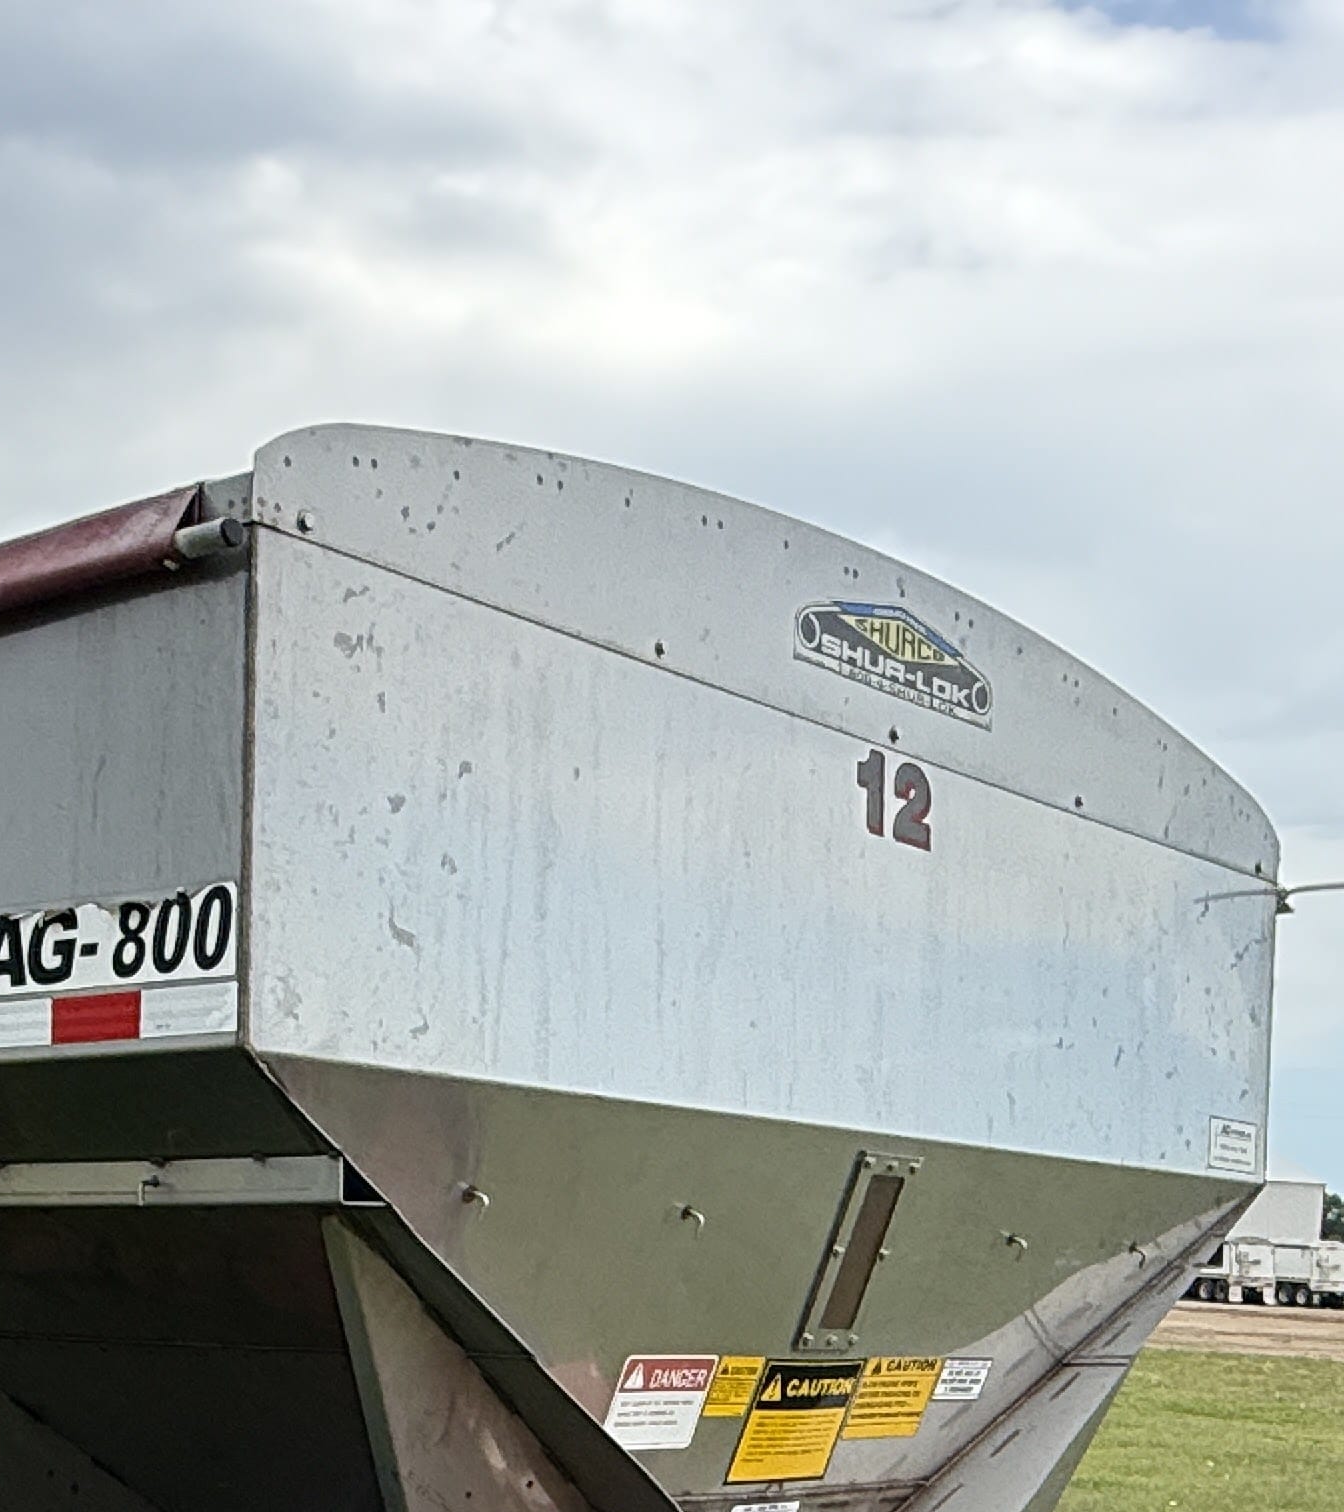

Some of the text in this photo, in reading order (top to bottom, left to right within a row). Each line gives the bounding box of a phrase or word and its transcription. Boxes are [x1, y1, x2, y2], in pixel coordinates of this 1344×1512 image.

[854, 619, 946, 662] SHURCO
[821, 633, 970, 707] SHUR-LOK
[856, 749, 932, 852] 12
[649, 1368, 708, 1389] DANGER
[886, 1358, 938, 1372] CAUTION
[786, 1377, 856, 1398] CAUTION
